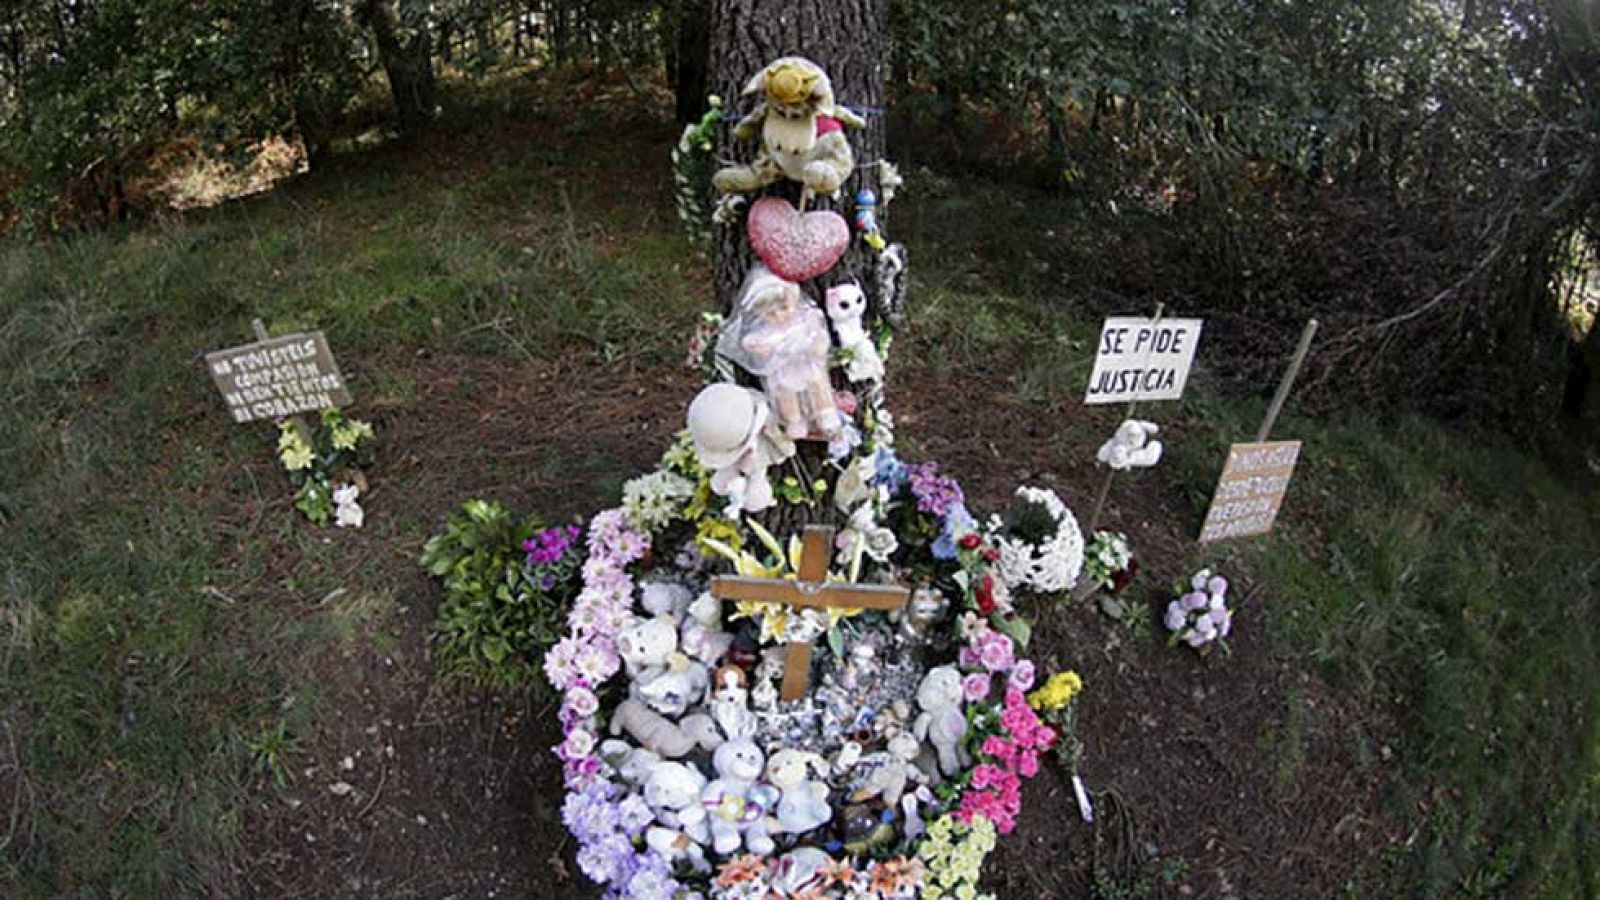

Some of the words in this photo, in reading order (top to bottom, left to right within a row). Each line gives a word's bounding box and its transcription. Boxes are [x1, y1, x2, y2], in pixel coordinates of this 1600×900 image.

[1102, 327, 1129, 355] SE
[1134, 327, 1187, 354] PIDE
[252, 391, 334, 418] CORAZON
